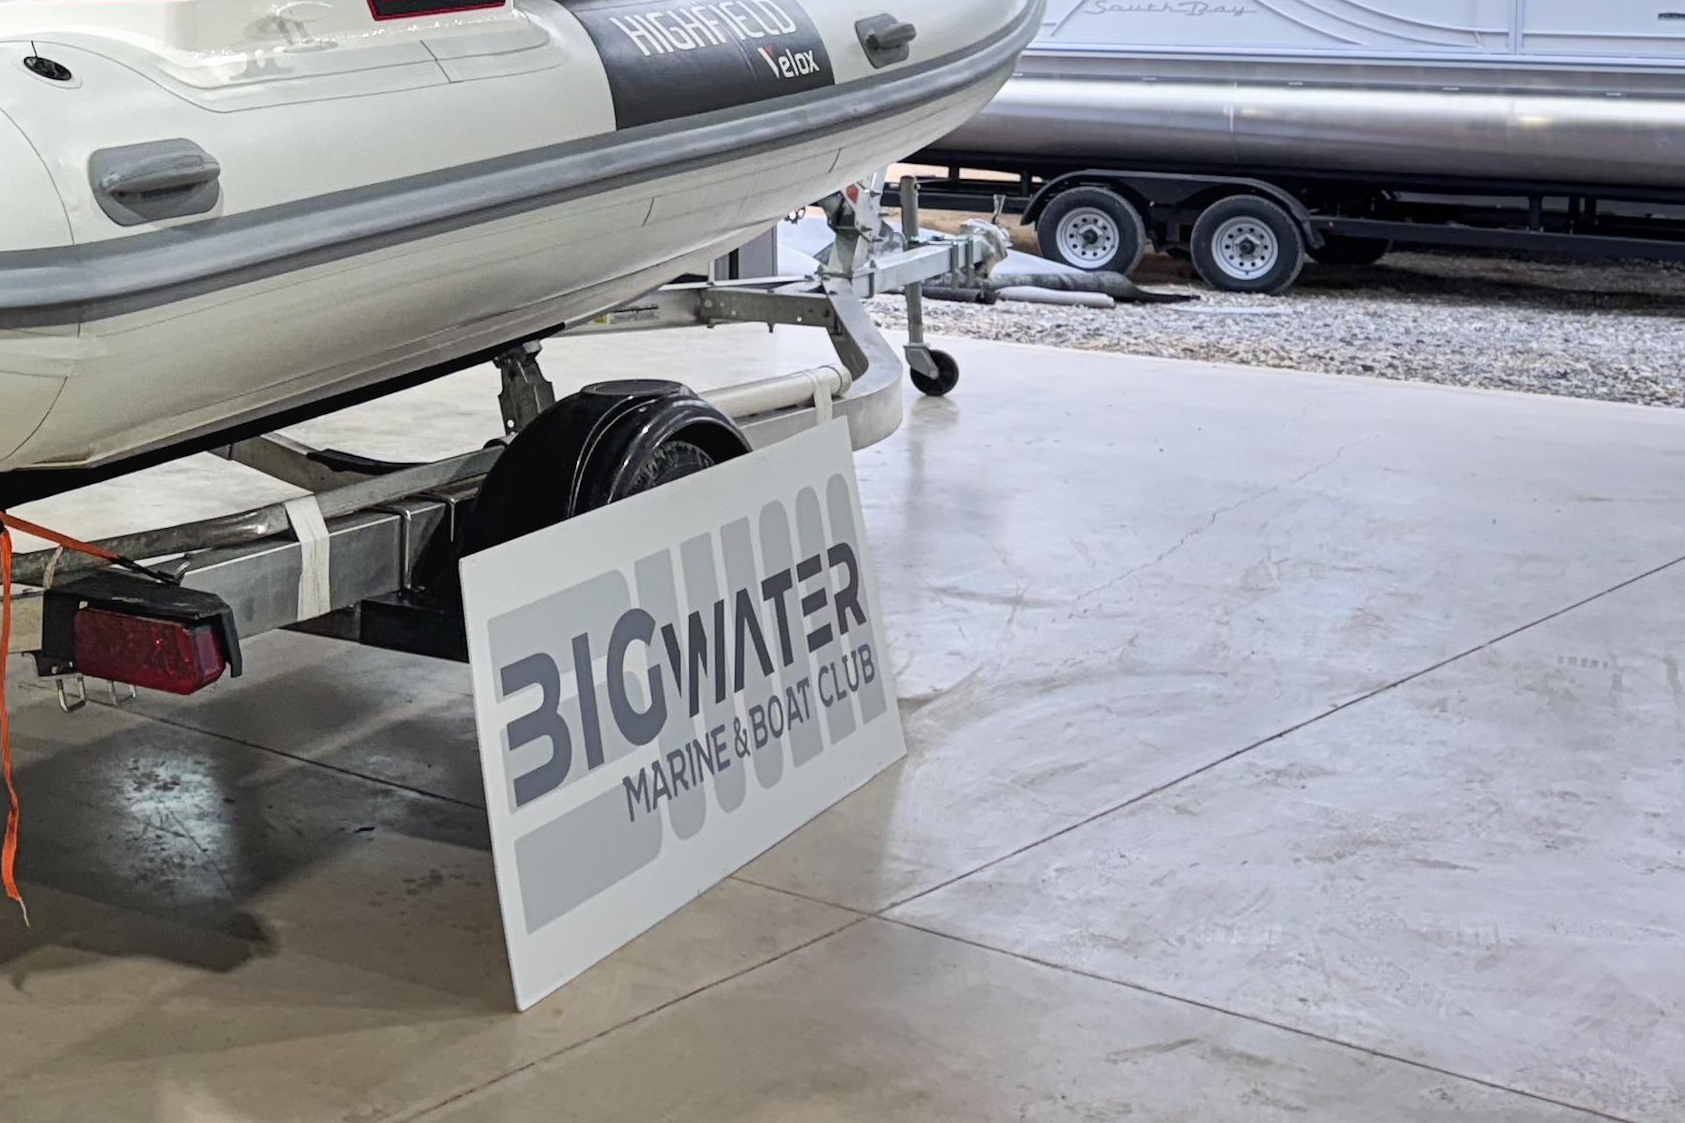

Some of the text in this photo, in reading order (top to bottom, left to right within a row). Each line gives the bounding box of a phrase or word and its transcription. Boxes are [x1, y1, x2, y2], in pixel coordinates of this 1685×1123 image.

[757, 44, 820, 79] Velox
[1084, 0, 1257, 16] South Bay
[500, 541, 867, 807] BIGWATER
[622, 643, 876, 822] MARINE & BOAT CLUB
